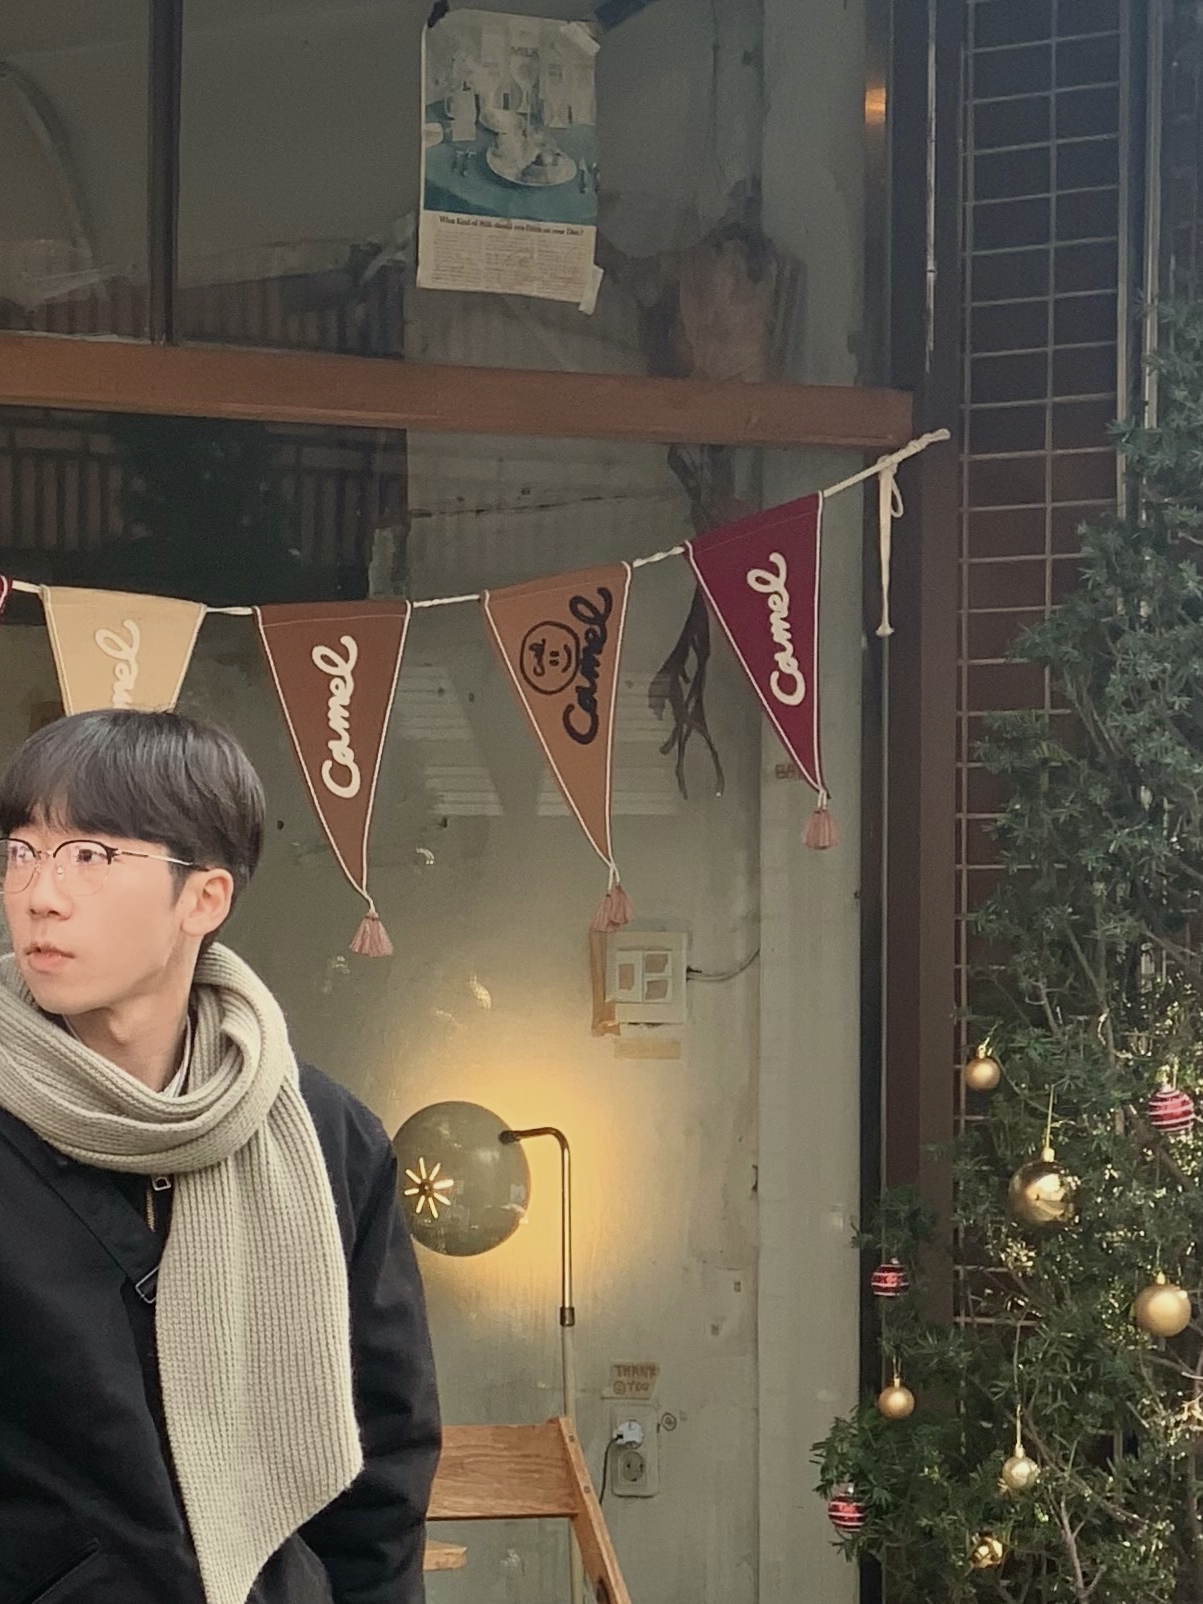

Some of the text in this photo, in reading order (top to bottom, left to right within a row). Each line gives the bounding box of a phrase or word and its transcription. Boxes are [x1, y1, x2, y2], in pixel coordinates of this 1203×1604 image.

[562, 587, 614, 746] Camel
[746, 552, 806, 706] Camel
[311, 635, 361, 799] Camel
